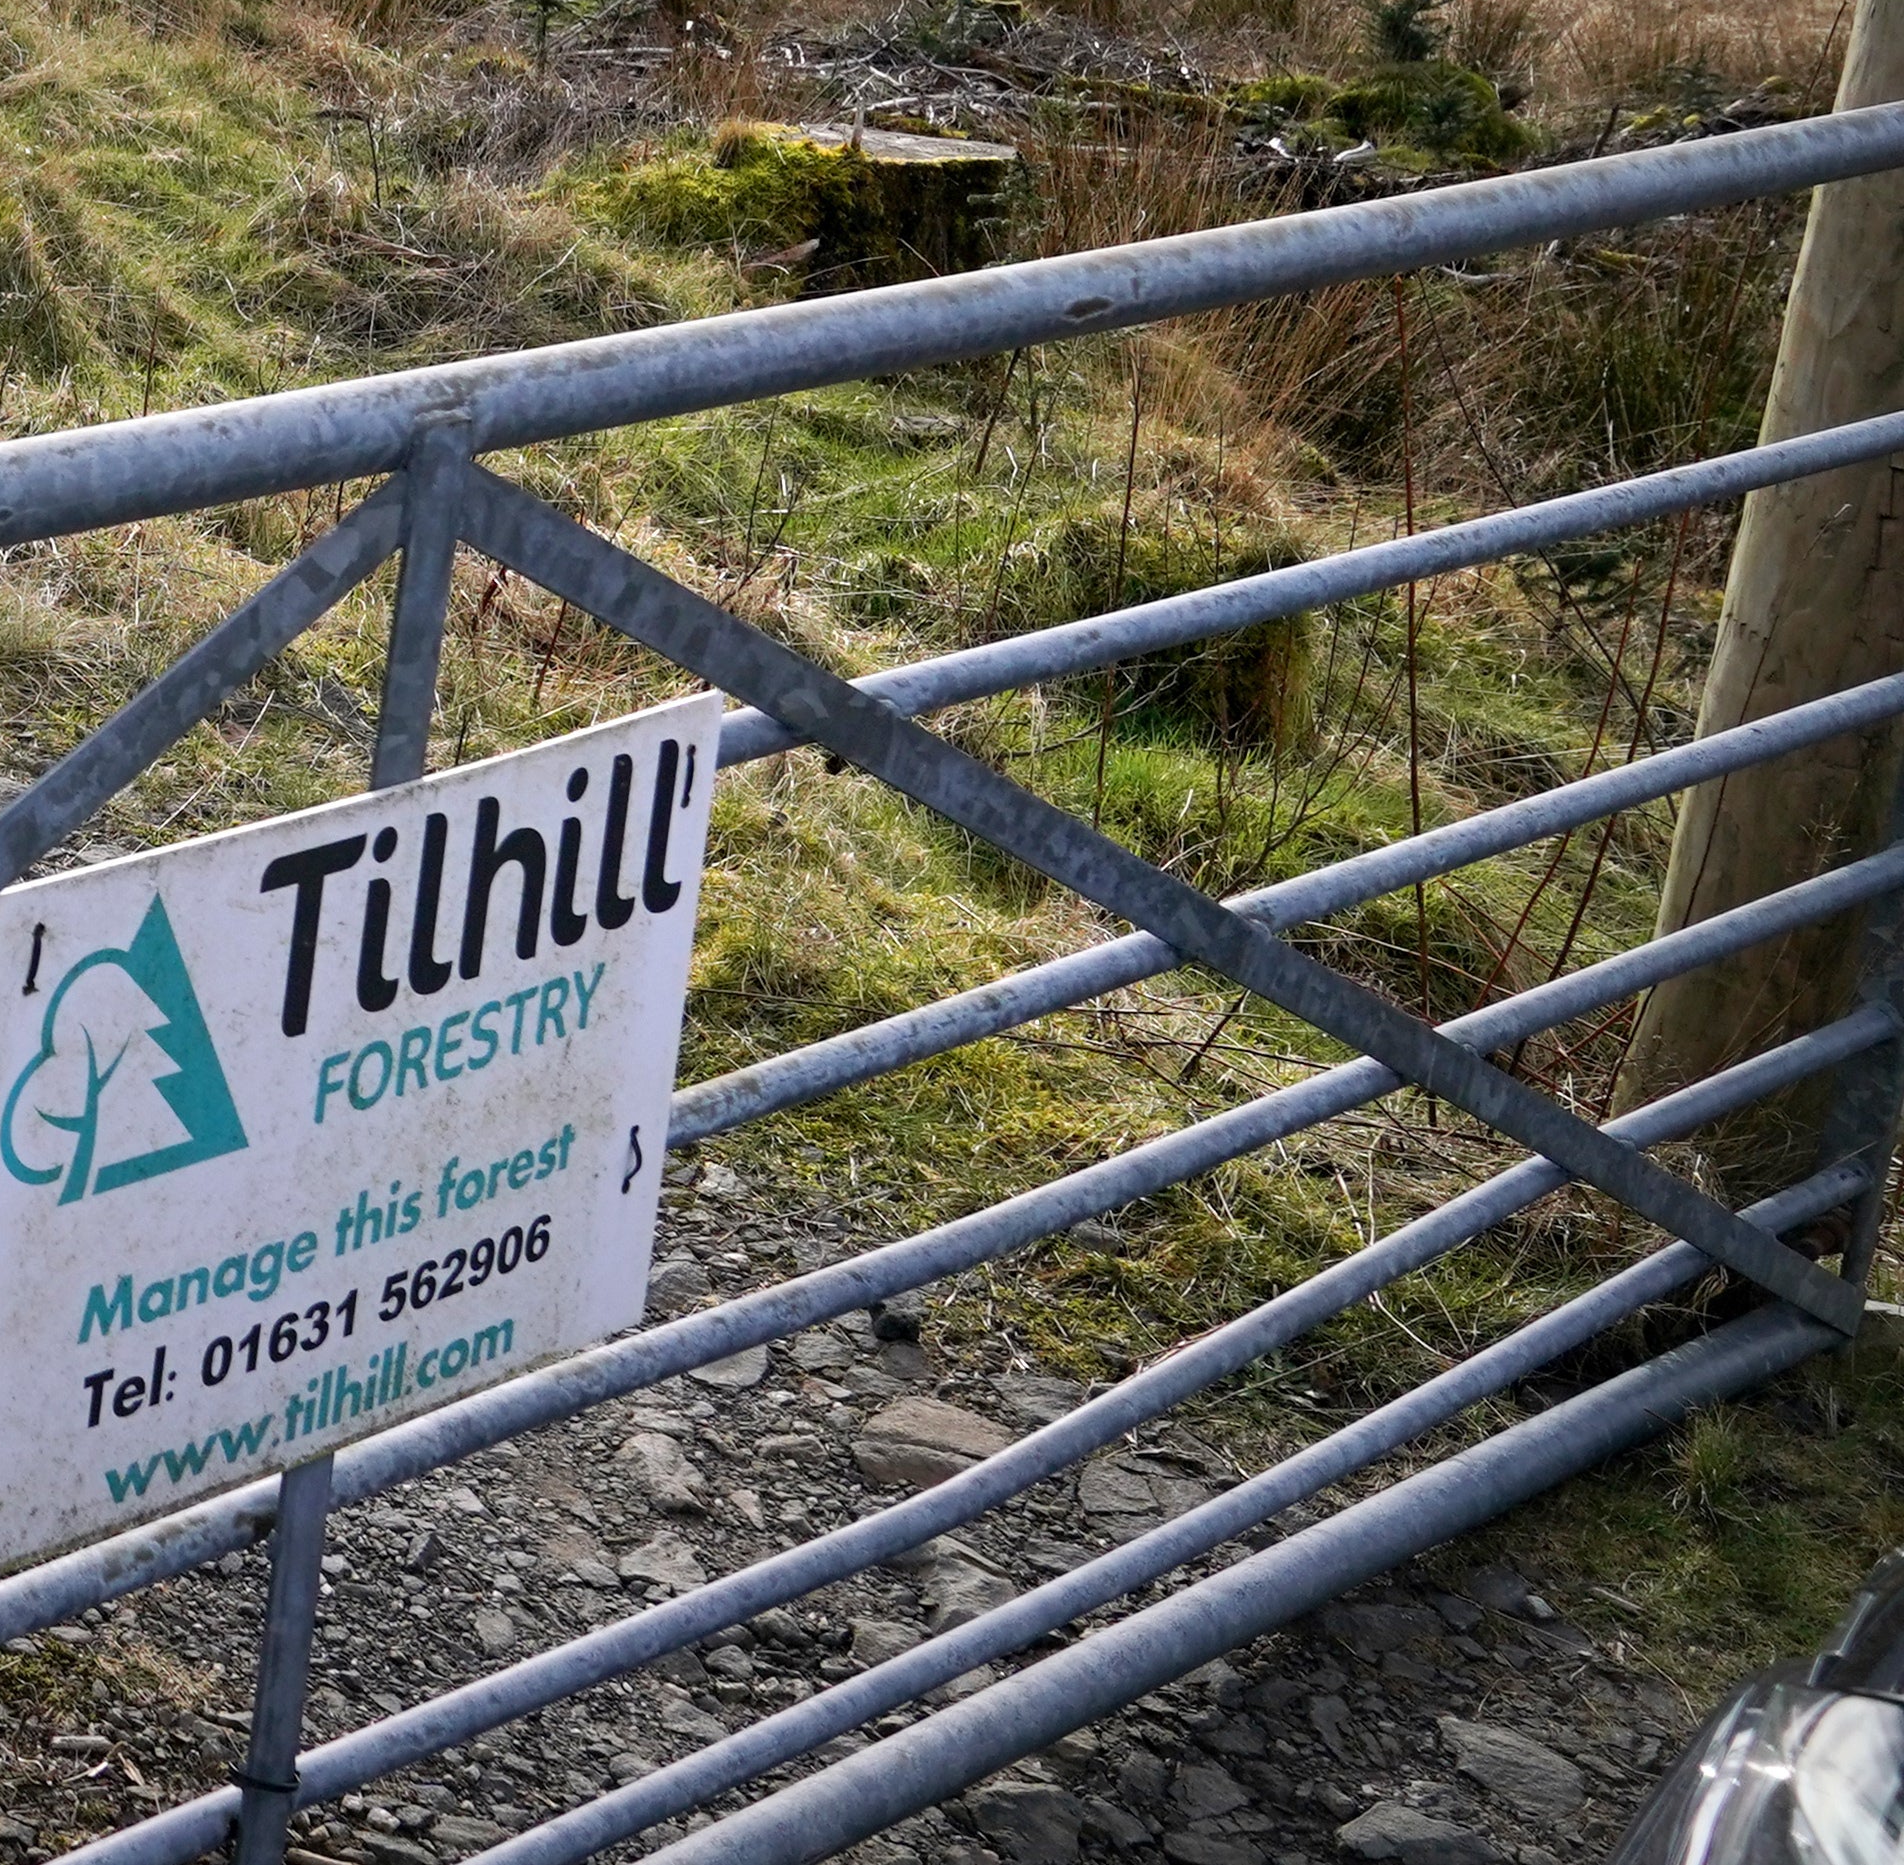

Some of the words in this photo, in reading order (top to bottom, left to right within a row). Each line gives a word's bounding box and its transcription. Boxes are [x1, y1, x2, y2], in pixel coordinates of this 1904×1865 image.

[260, 739, 682, 1037] Tilhill
[314, 963, 606, 1124] FORESTRY
[77, 1227, 317, 1344] Manage
[334, 1179, 423, 1257] this
[437, 1123, 575, 1221] forest
[83, 1345, 177, 1428] Tel:
[201, 1290, 357, 1389] 01631
[380, 1215, 552, 1322] 562906
[104, 1317, 515, 1504] www.tilhill.com
